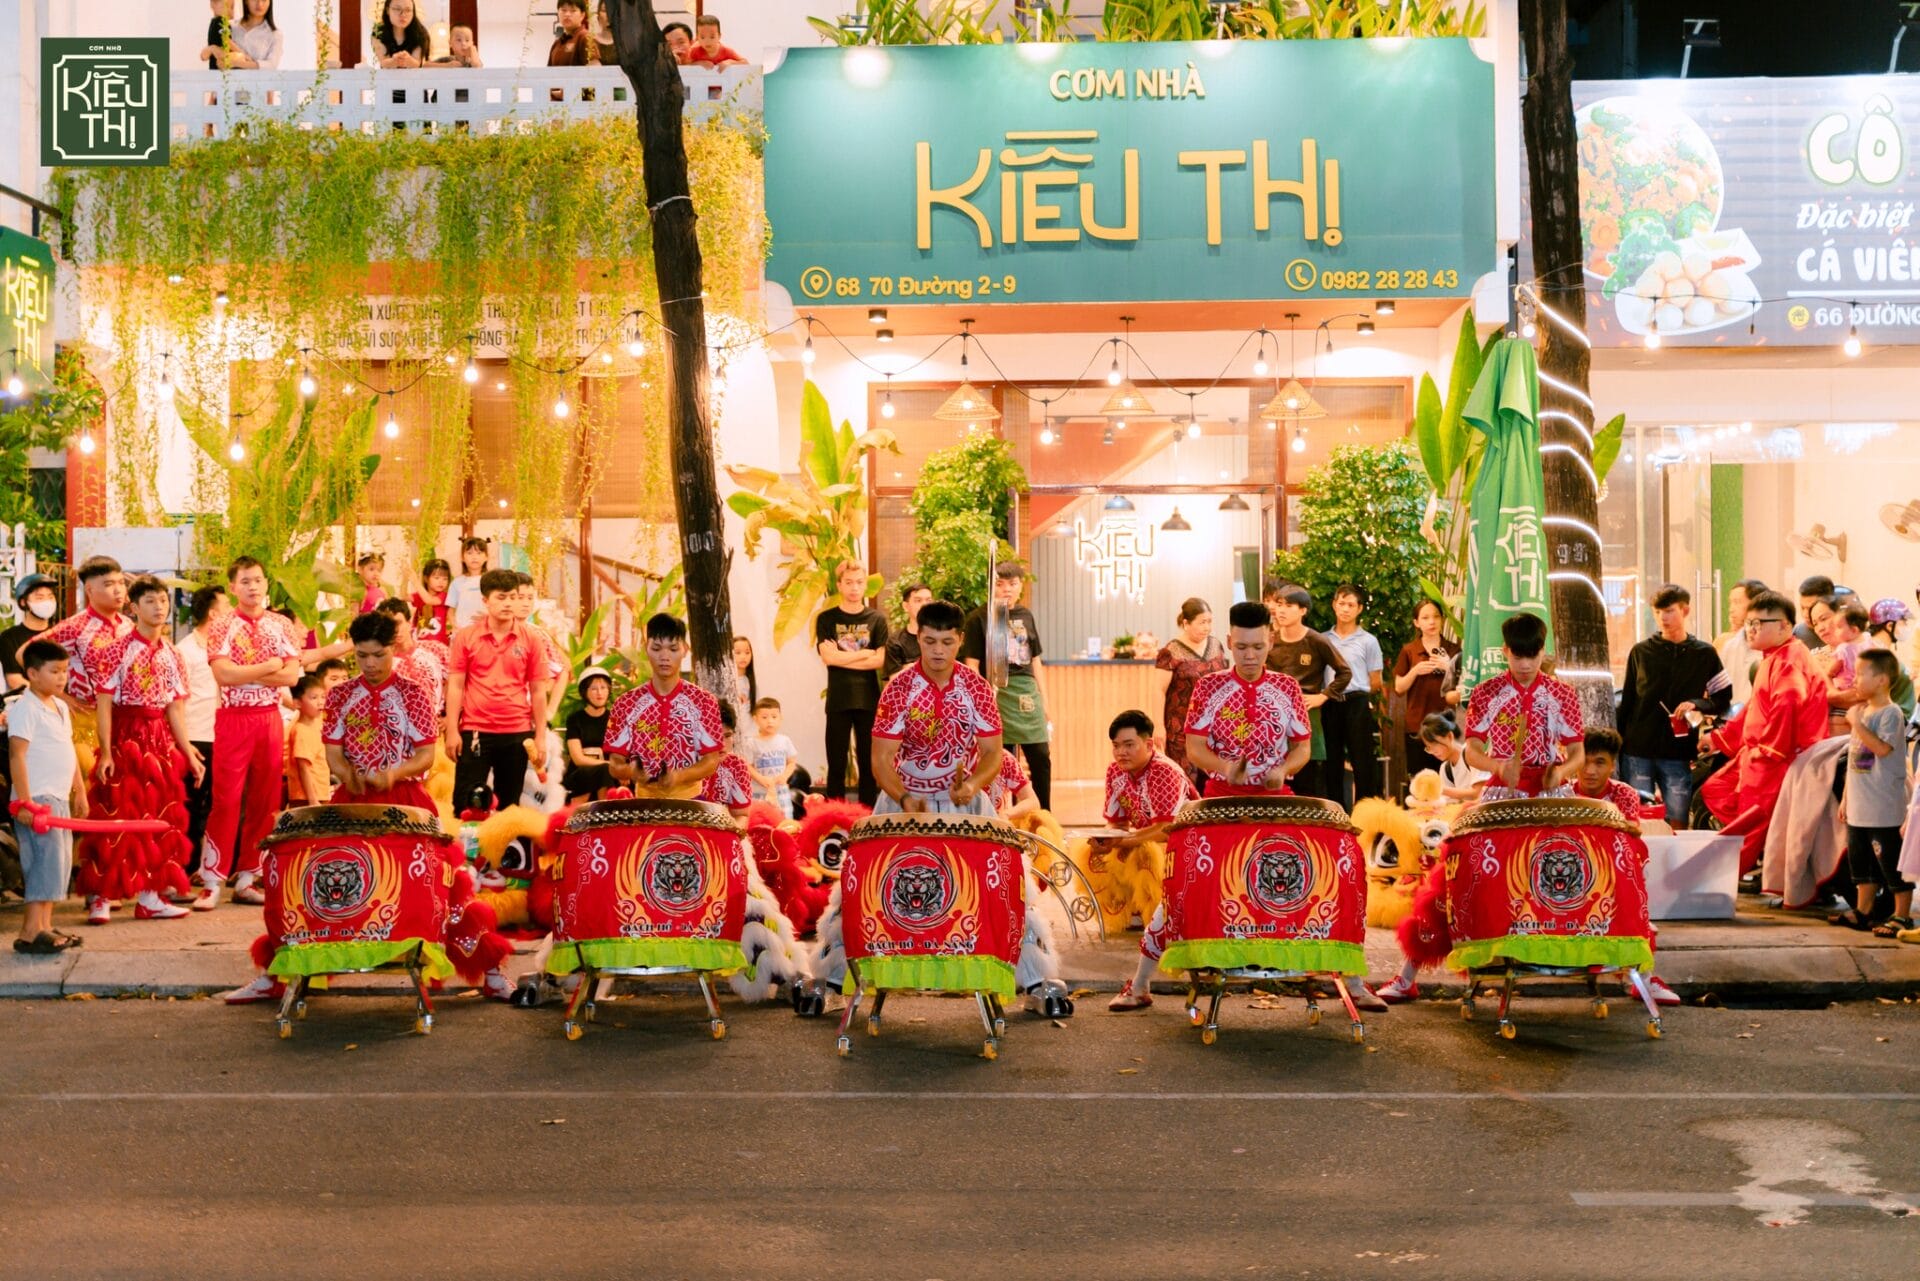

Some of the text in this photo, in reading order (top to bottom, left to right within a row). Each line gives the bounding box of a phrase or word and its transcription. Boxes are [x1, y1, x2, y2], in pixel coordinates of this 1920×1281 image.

[1050, 61, 1206, 100] CƠM NHÀ
[1808, 93, 1903, 185] CÔ
[916, 130, 1343, 250] KIỀU THỊ
[1796, 201, 1915, 236] Đặc biệt
[1797, 238, 1842, 281] CÁ
[835, 277, 860, 296] 68
[869, 276, 893, 296] 70
[898, 275, 973, 299] Đường
[1321, 269, 1459, 290] 0982 28 28 43
[1814, 307, 1844, 326] 66
[1078, 518, 1154, 561] KIỀU
